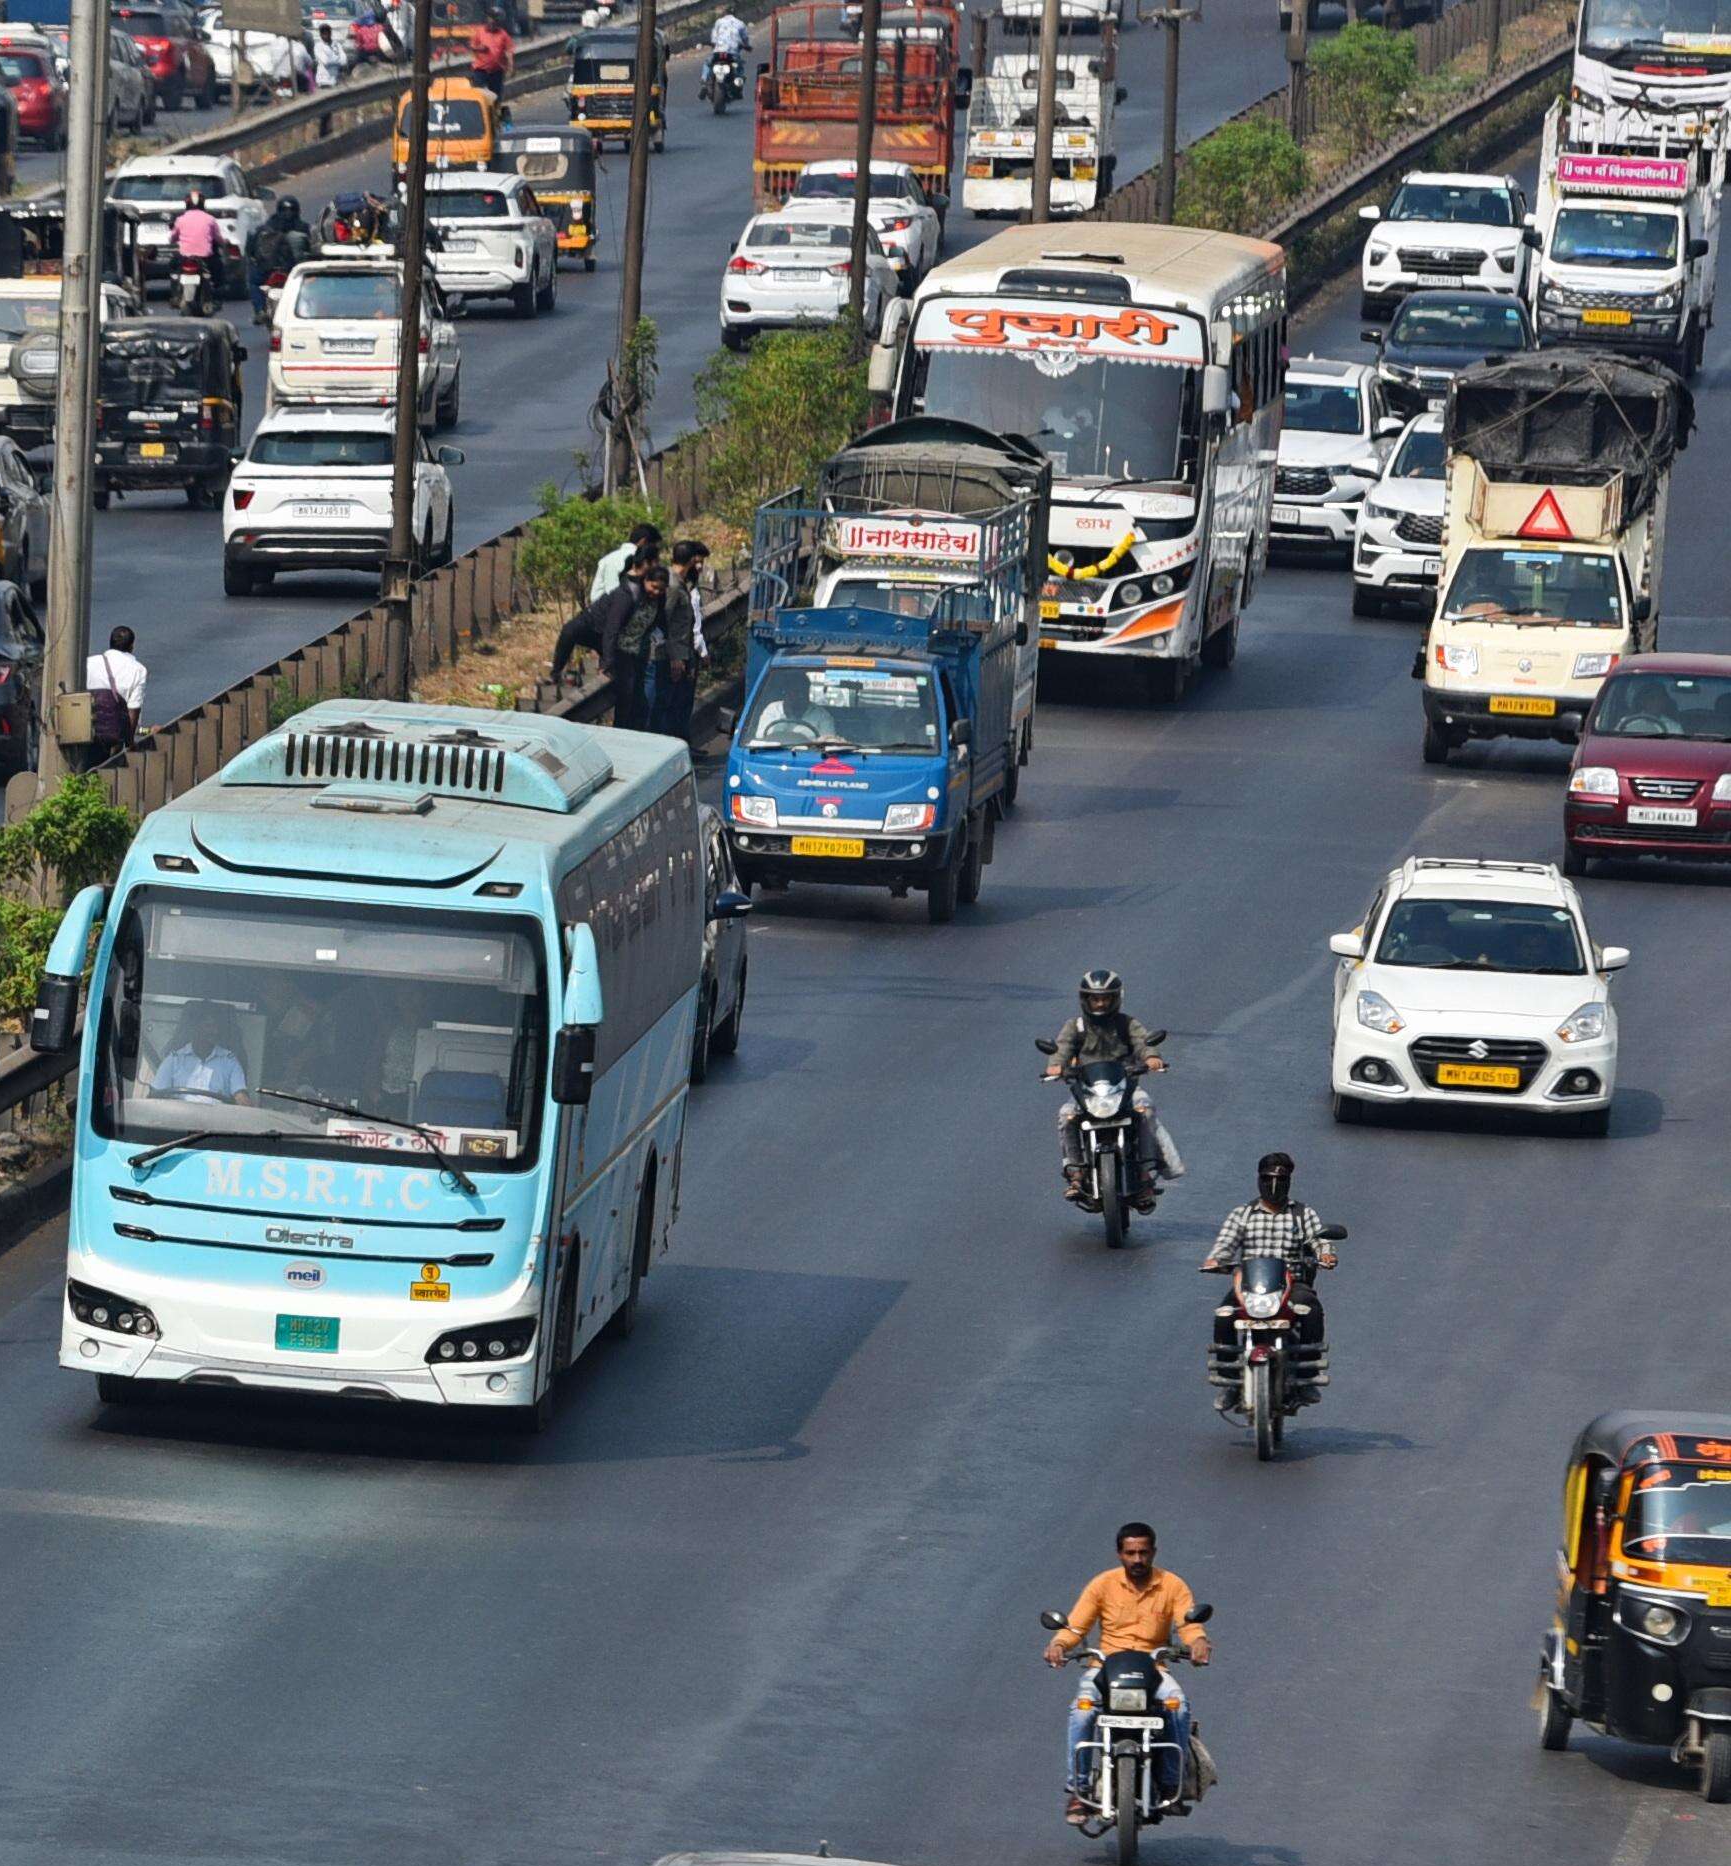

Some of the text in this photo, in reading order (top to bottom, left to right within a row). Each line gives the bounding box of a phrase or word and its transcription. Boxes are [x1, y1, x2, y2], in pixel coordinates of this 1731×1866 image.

[945, 309, 1179, 346] पुजारी
[796, 778, 869, 790] ASHOK LEYLAND
[287, 1268, 320, 1281] meil
